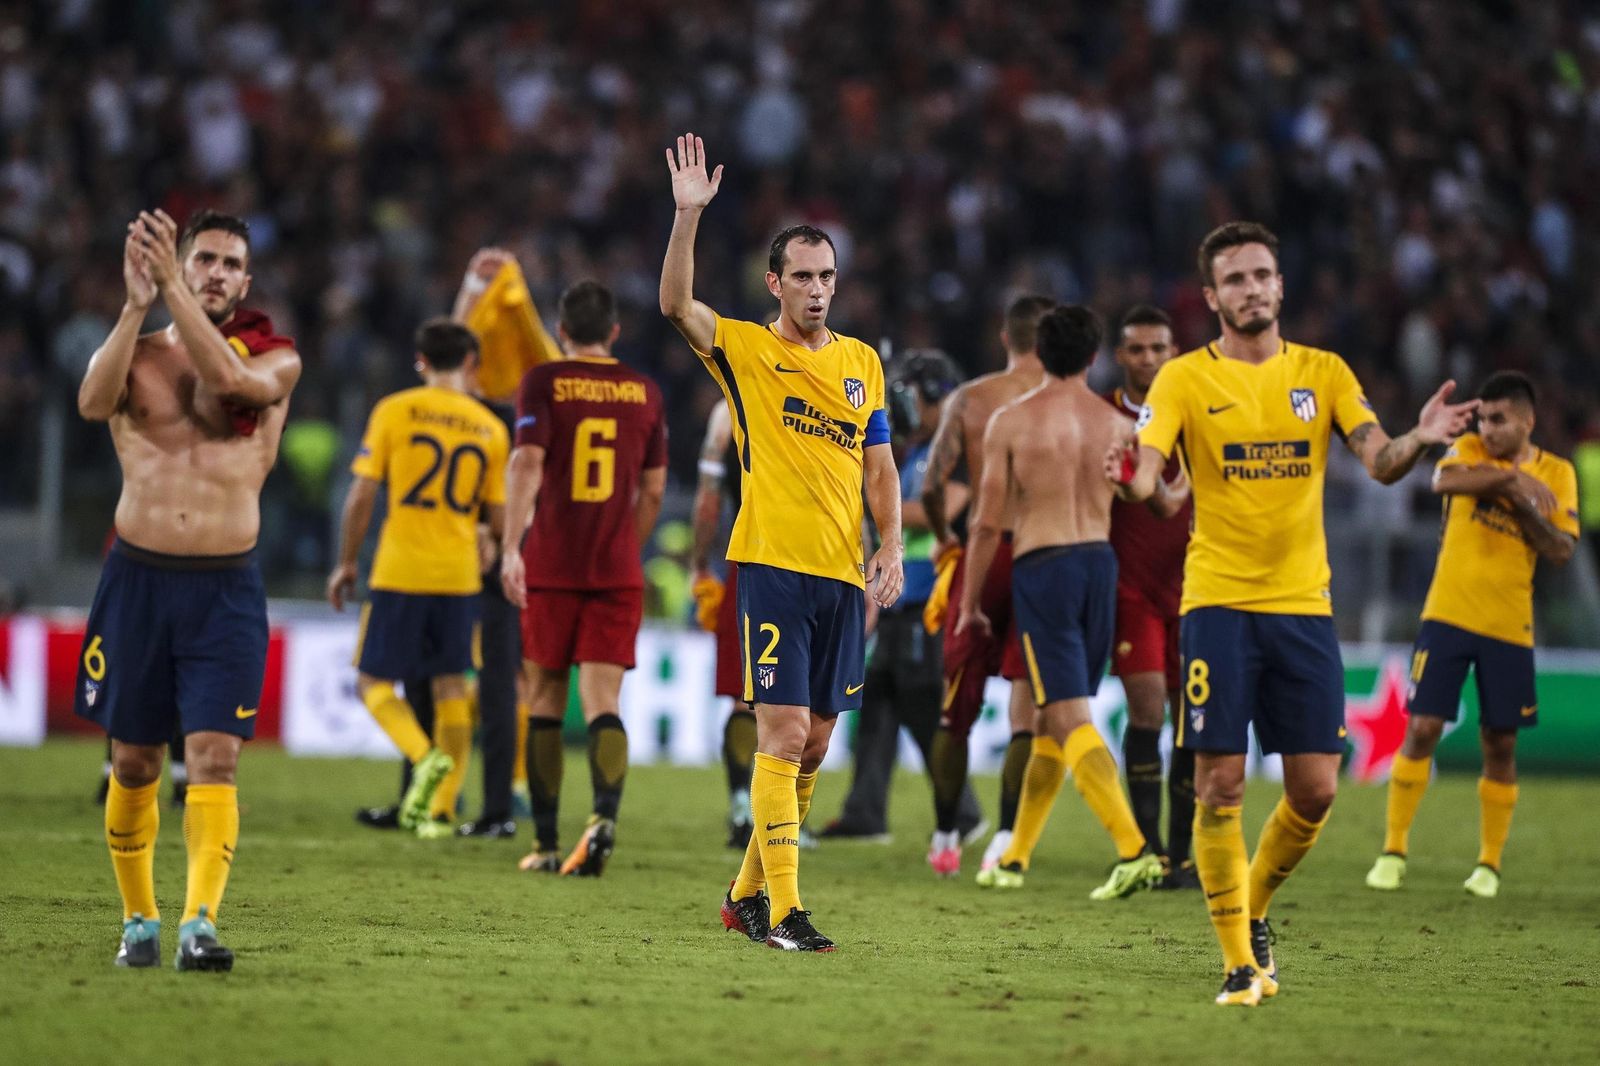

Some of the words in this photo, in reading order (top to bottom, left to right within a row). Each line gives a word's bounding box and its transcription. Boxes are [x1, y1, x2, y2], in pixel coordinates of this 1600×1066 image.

[400, 433, 488, 514] 20
[571, 417, 617, 502] 6
[1223, 462, 1311, 481] Plus500
[1241, 442, 1295, 459] Trade
[84, 634, 106, 681] 6
[757, 622, 780, 664] 2
[1185, 658, 1210, 706] 8
